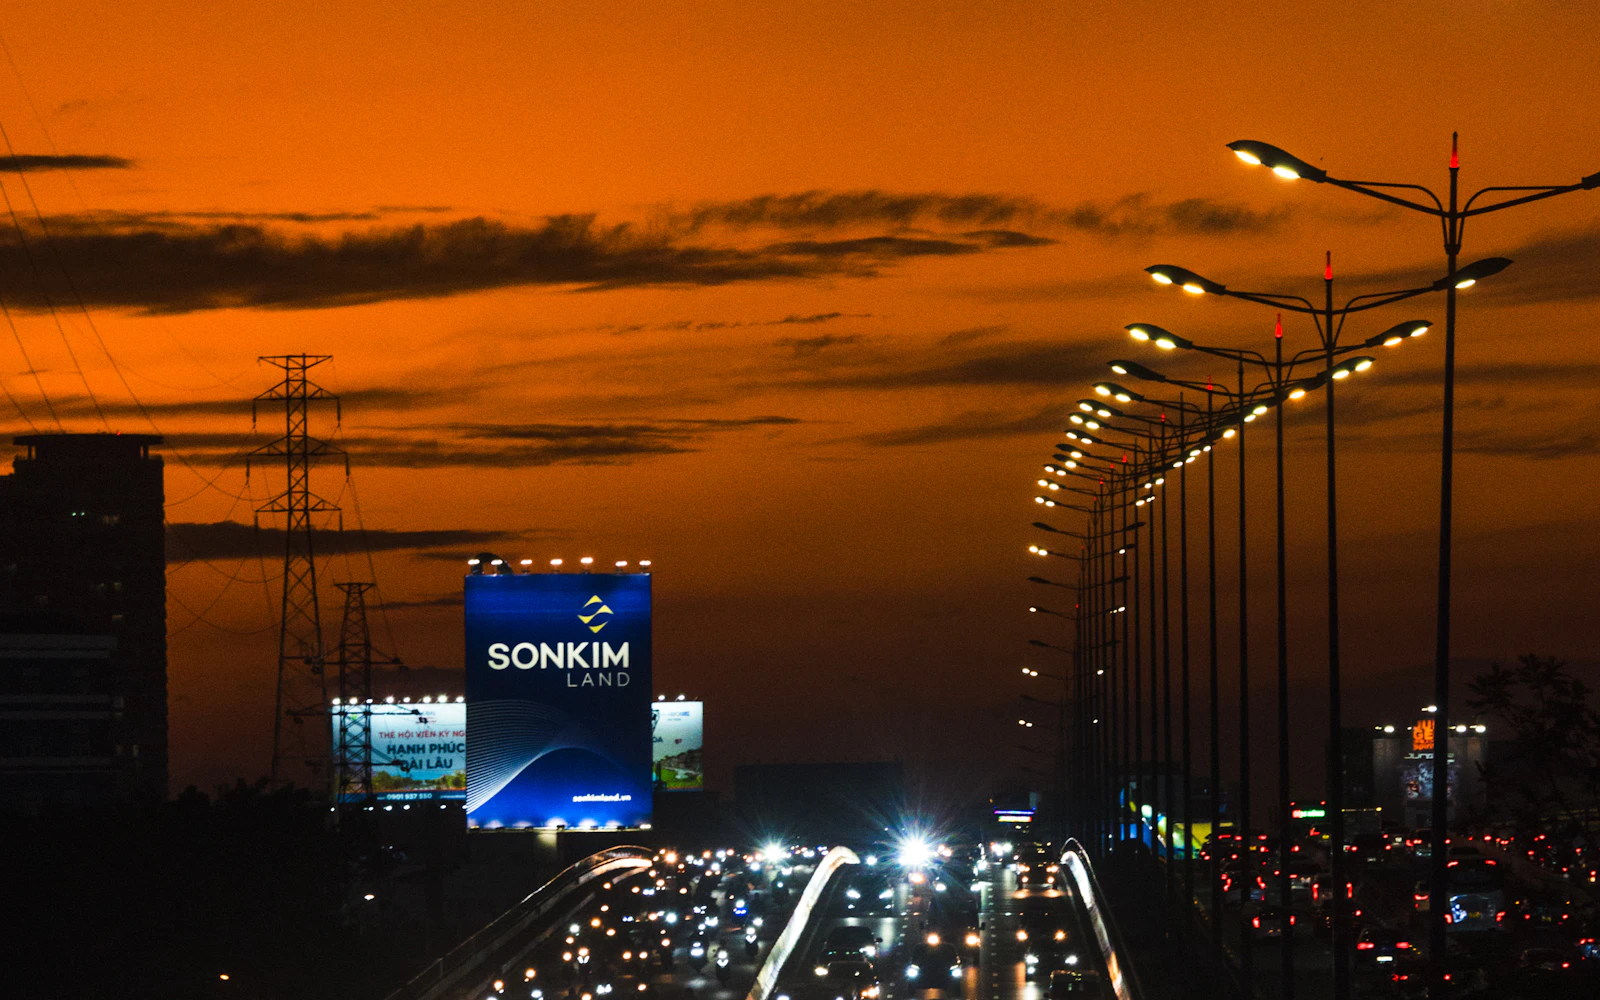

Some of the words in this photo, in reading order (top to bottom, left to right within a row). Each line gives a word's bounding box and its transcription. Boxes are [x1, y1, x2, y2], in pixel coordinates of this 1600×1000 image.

[488, 641, 630, 670] SONKIM
[566, 672, 630, 687] LAND
[387, 743, 426, 757] HẠNH
[429, 741, 465, 754] PHÚC
[427, 756, 453, 769] LÂU
[572, 793, 632, 803] sonkimland.vn
